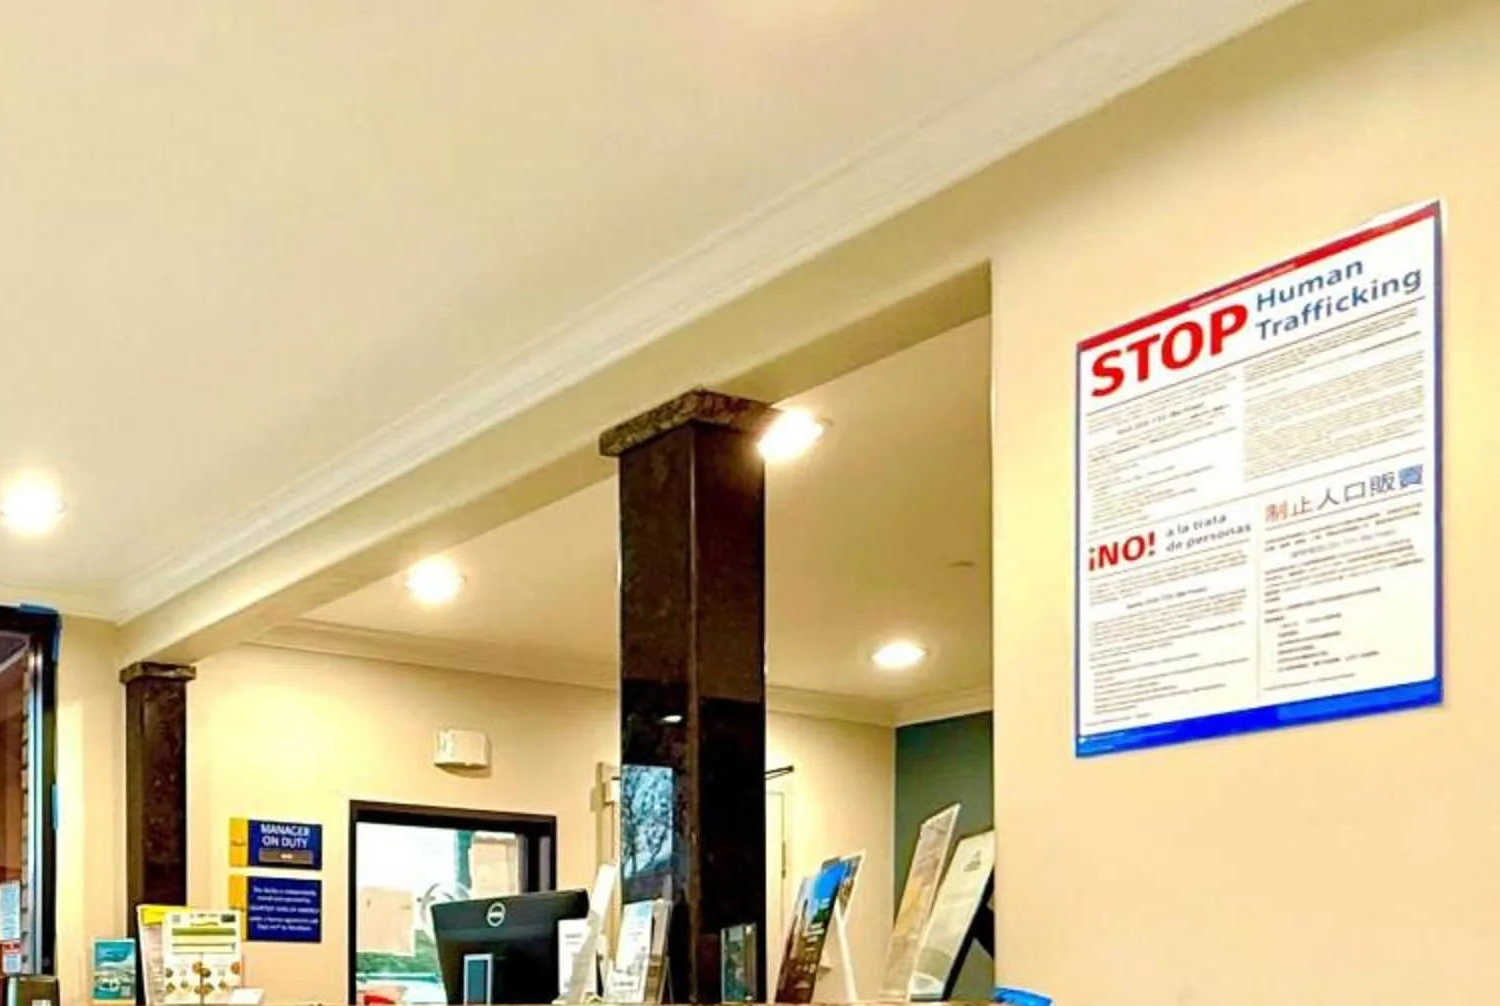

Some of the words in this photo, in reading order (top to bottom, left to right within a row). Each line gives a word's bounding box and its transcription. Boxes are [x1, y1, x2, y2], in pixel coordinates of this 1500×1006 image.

[1256, 259, 1363, 312] Human
[1255, 268, 1422, 342] Trafficking
[1091, 303, 1248, 397] STOP
[1165, 540, 1183, 552] de
[1186, 523, 1252, 550] personas
[1177, 523, 1190, 534] la
[1192, 513, 1227, 532] trata
[260, 823, 311, 837] MANAGER
[262, 836, 279, 847] ON
[281, 837, 309, 849] DUTY
